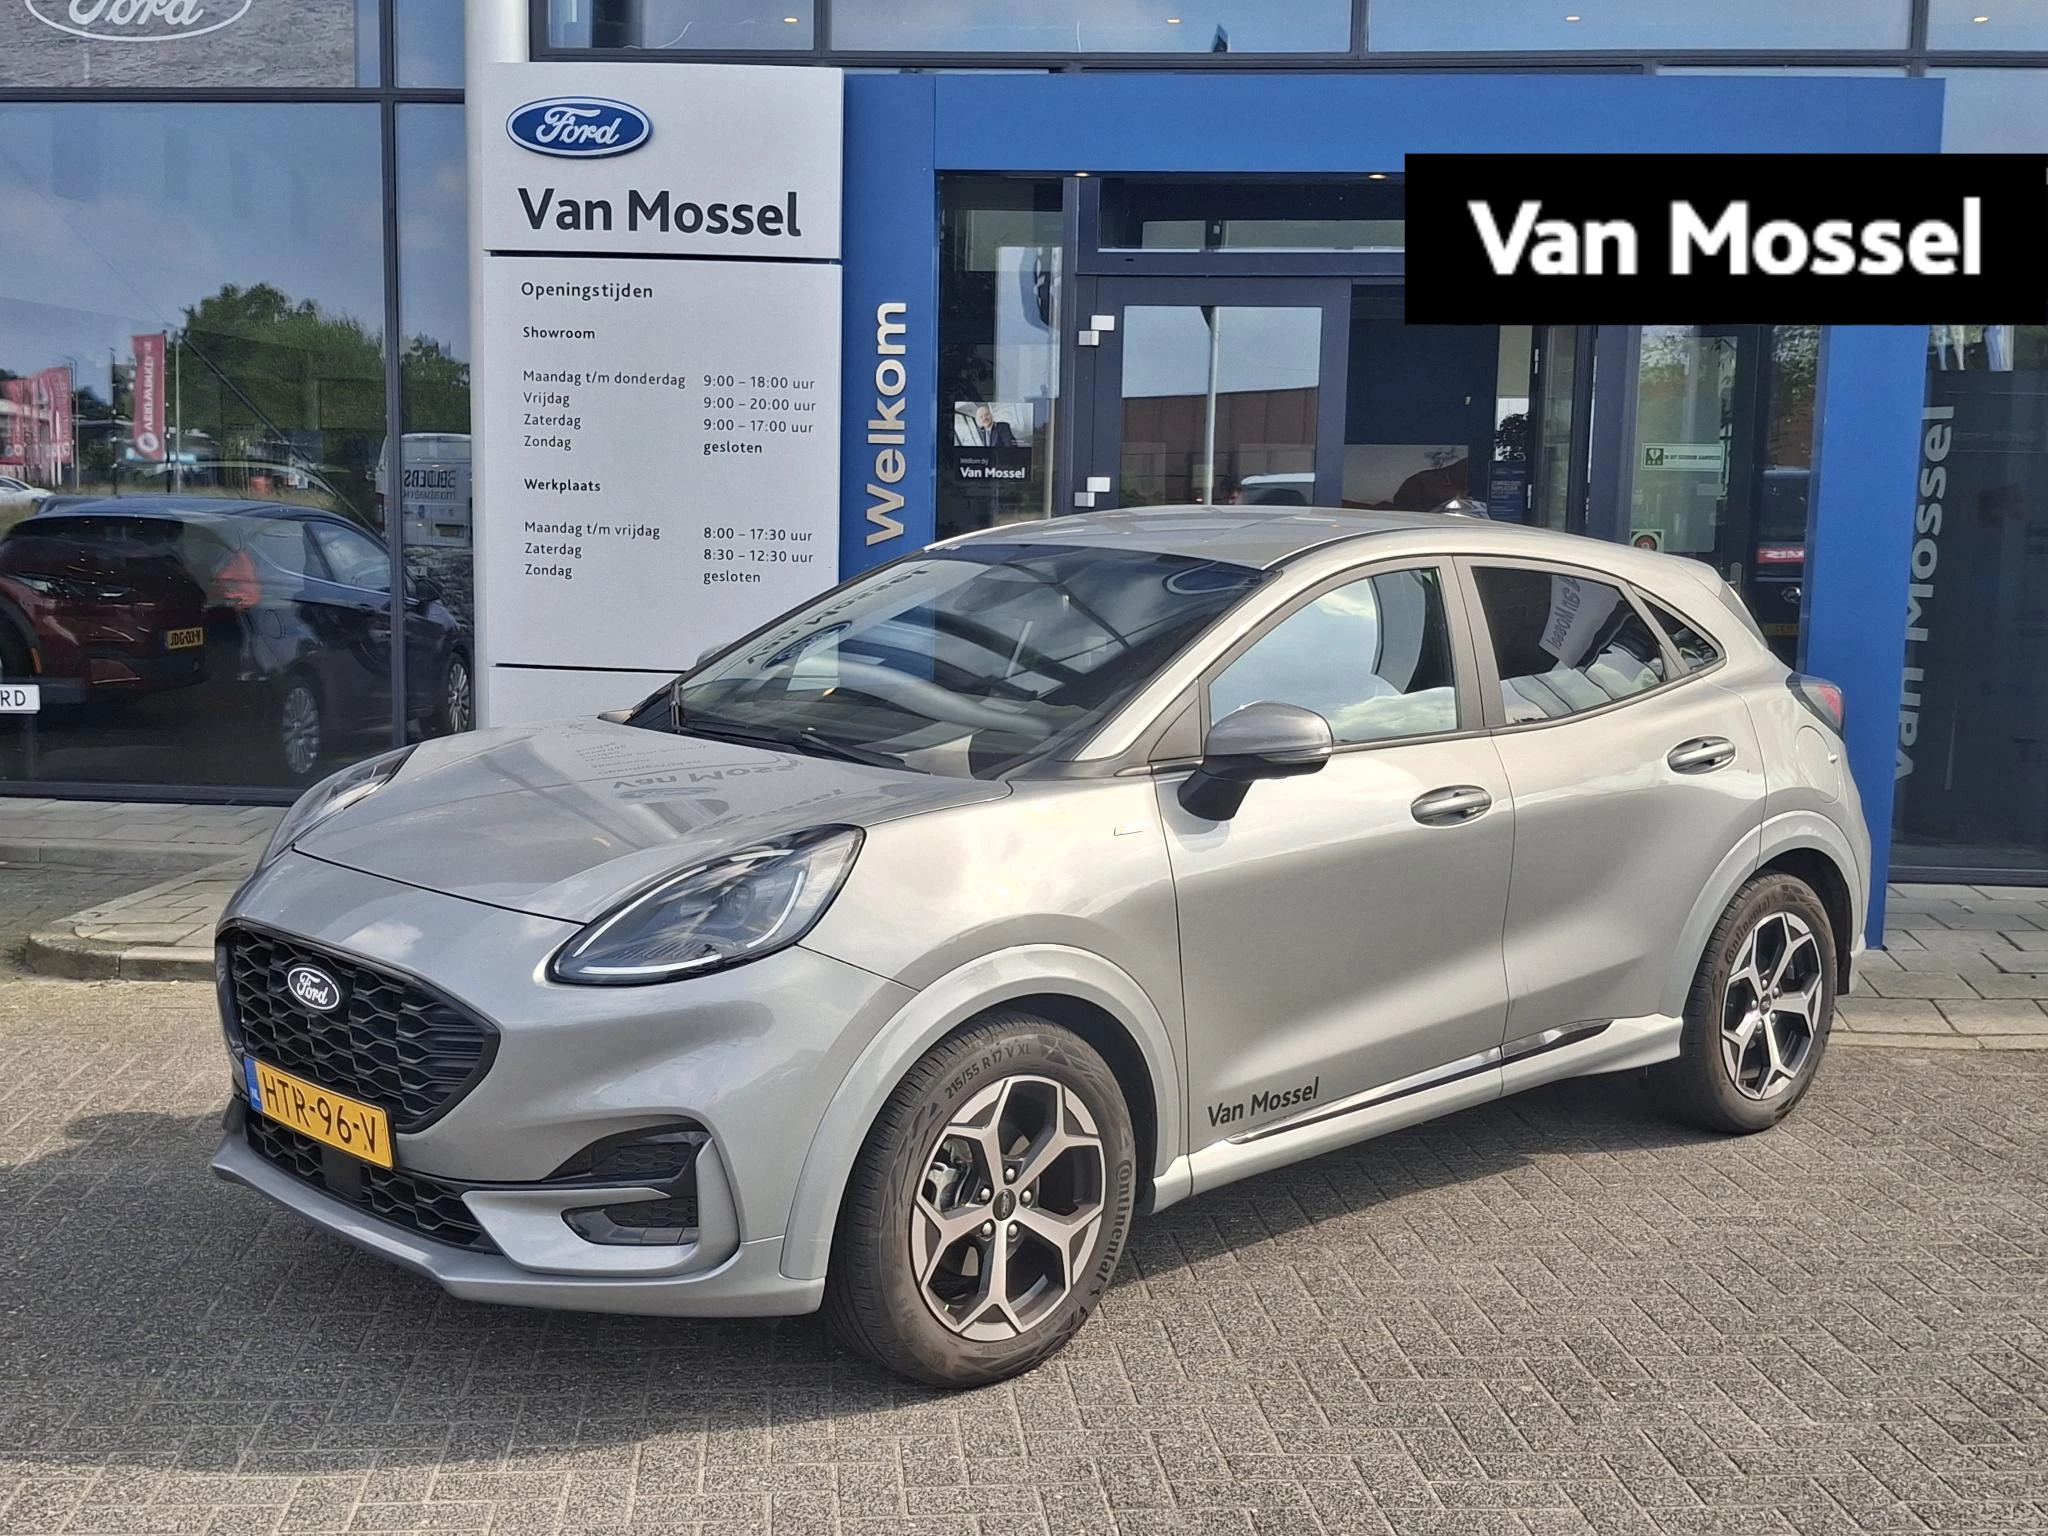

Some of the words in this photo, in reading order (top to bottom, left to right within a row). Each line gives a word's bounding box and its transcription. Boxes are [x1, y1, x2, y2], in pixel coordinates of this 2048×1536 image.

[535, 106, 622, 144] Ford
[516, 187, 613, 232] Van
[627, 189, 802, 238] Mossel
[520, 279, 653, 303] Openingstijden
[520, 324, 598, 340] Showroom
[523, 368, 582, 387] Maandag
[585, 370, 610, 384] t/m
[613, 371, 686, 390] donderdag
[703, 374, 735, 389] 9:00
[749, 375, 789, 389] 18:00
[792, 379, 816, 390] uur
[522, 391, 571, 409] Vrijdag
[703, 395, 735, 410] 9:00
[749, 397, 792, 411] 20:00
[793, 401, 817, 413] uur
[522, 412, 584, 432] Zaterdag
[703, 417, 735, 433] 9:00
[749, 419, 787, 433] 17:00
[791, 423, 814, 434] uur
[866, 302, 907, 546] Welkom
[523, 434, 574, 452] Zondag
[703, 439, 763, 456] gesloten
[960, 467, 982, 478] Van
[985, 467, 1025, 479] Mossel
[523, 477, 601, 496] Werkplaats
[524, 520, 583, 538] Maandag
[586, 522, 611, 536] t/m
[614, 523, 661, 541] vrijdag
[1905, 406, 1954, 641] Mossel
[703, 526, 735, 542] 8:00
[749, 527, 787, 542] 17:30
[790, 532, 813, 542] uur
[524, 541, 583, 560] Zaterdag
[703, 548, 735, 561] 8:30
[748, 548, 787, 563] 12:30
[791, 553, 815, 565] uur
[524, 563, 573, 582] Zondag
[703, 567, 761, 586] gesloten
[296, 971, 329, 1005] Ford
[944, 1062, 981, 1100] 215/55
[1207, 1102, 1244, 1127] Van
[1250, 1075, 1320, 1116] Mossel
[261, 1071, 376, 1154] HTR-96-V
[1097, 1159, 1132, 1283] Continental
